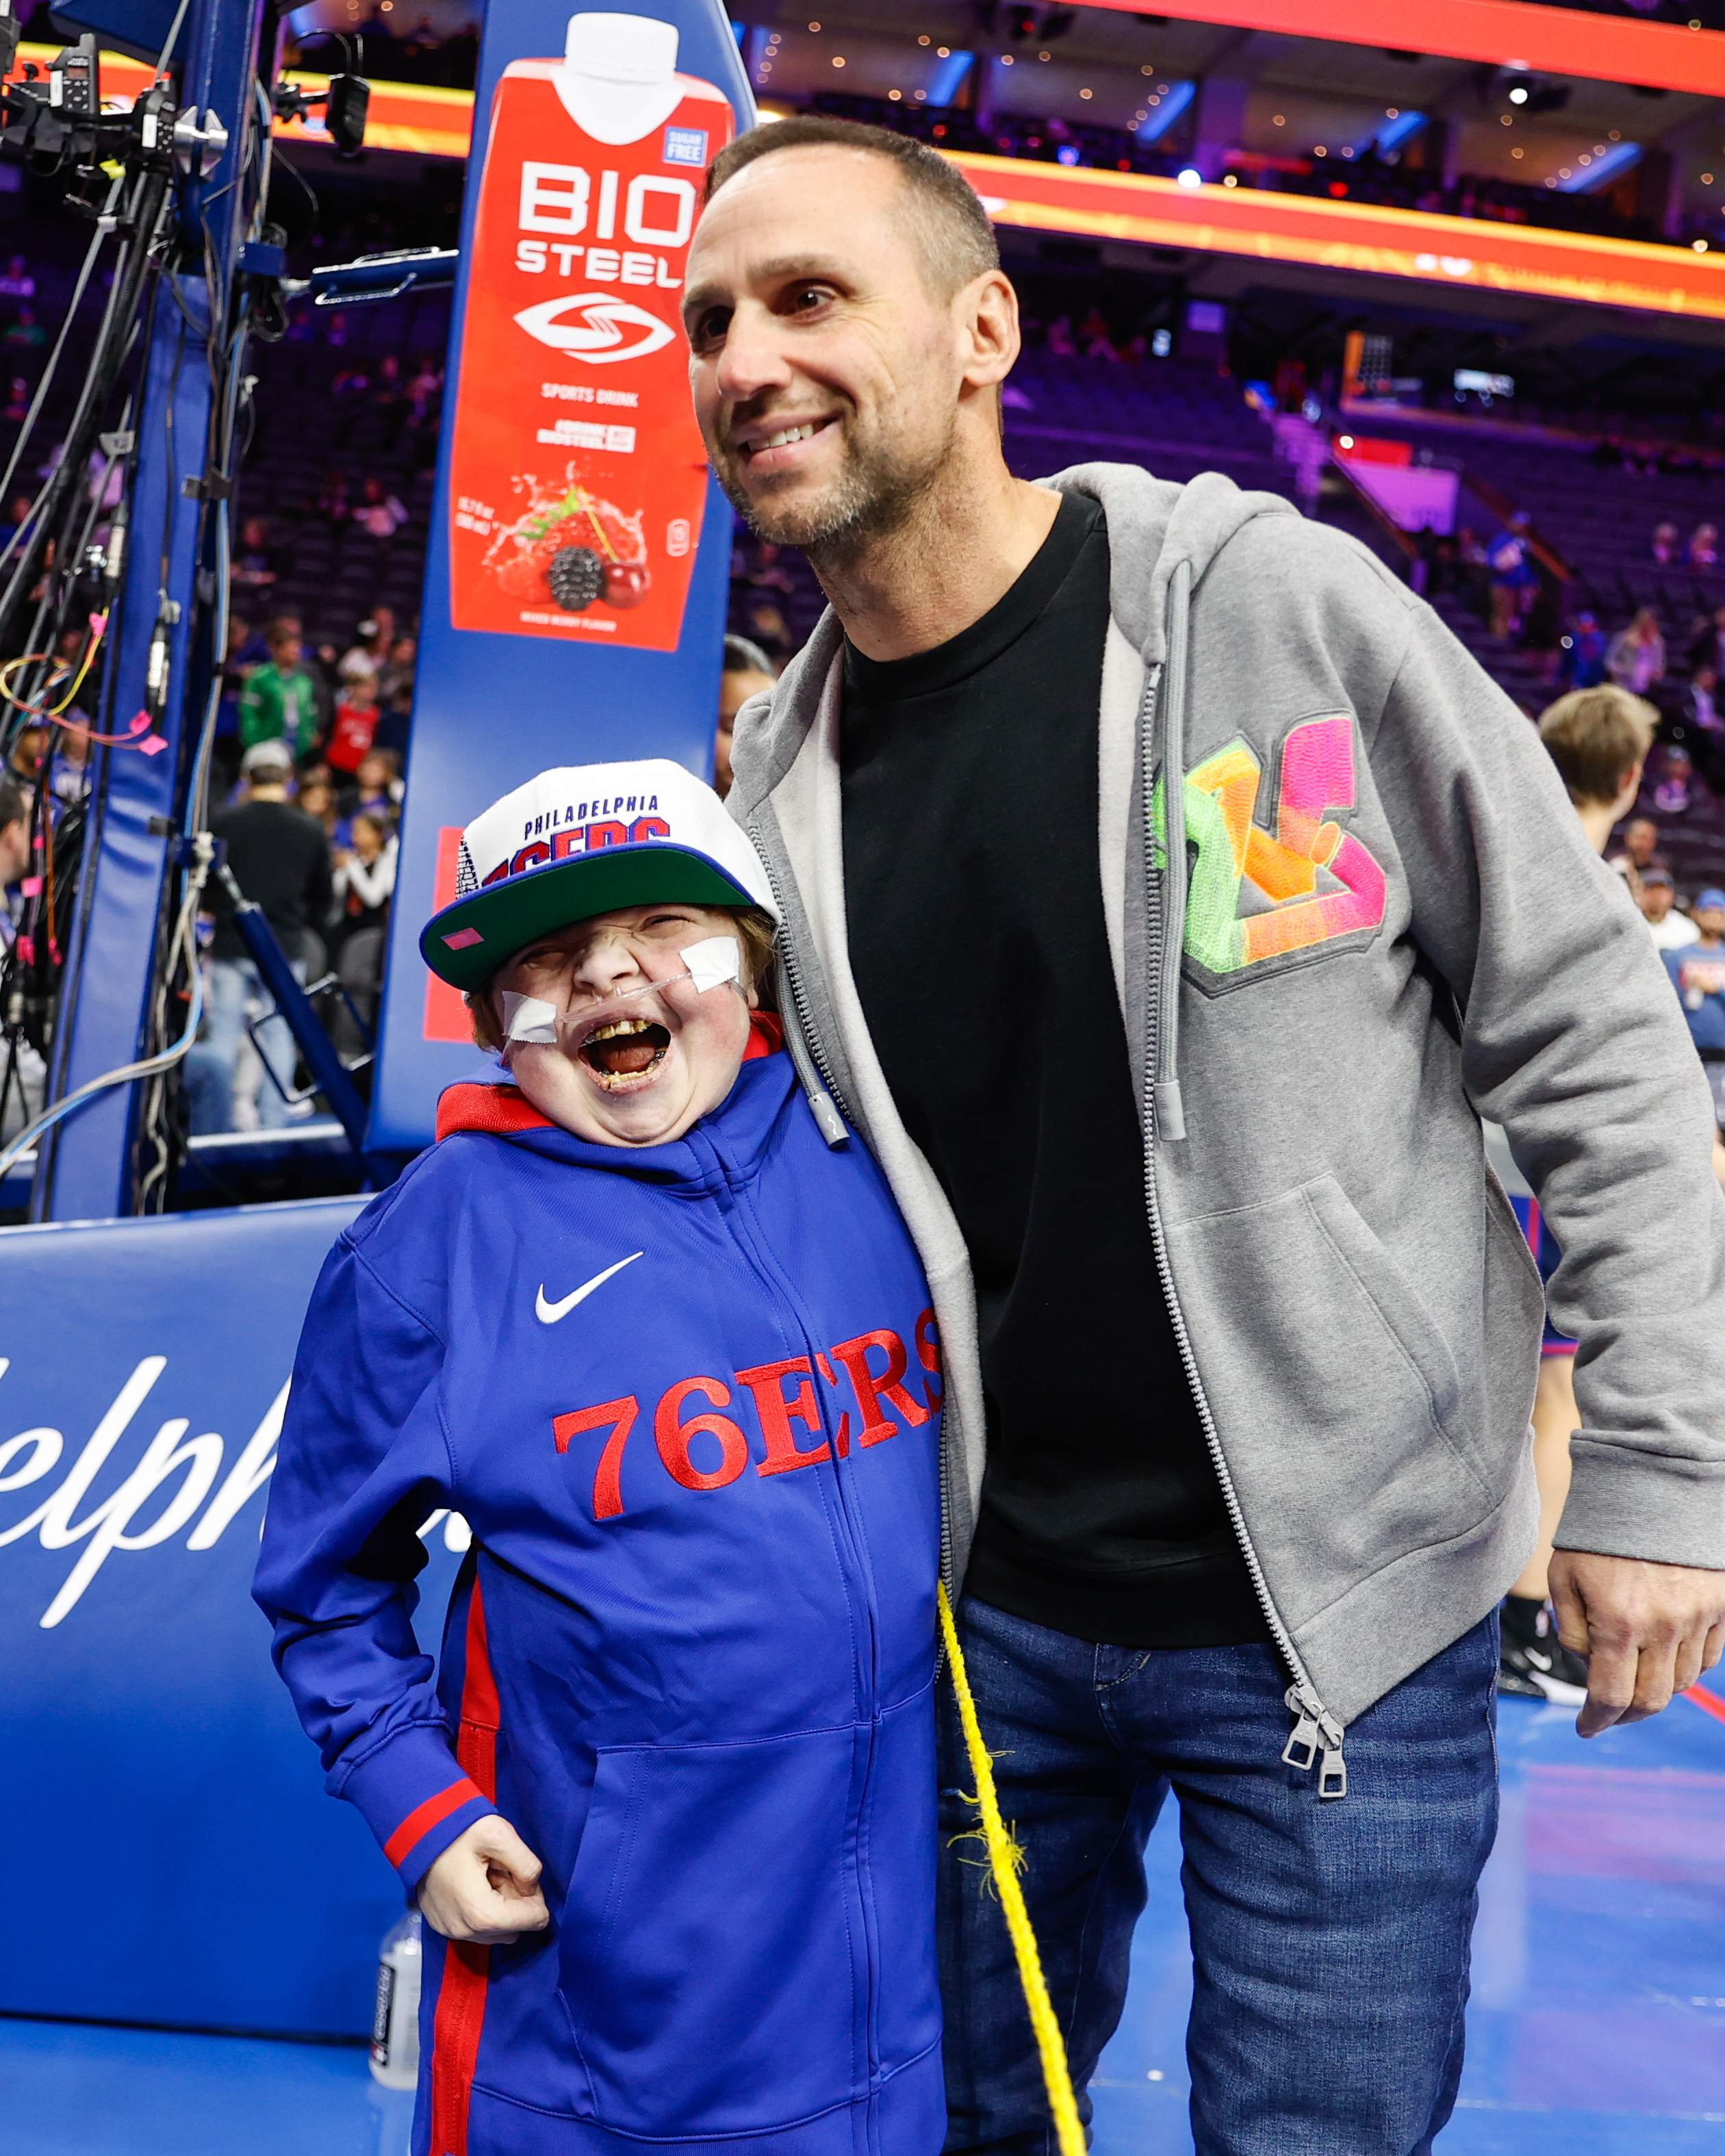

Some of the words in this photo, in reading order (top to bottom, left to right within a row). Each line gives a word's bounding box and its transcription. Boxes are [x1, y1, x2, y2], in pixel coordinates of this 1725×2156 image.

[667, 142, 702, 162] FREE
[669, 131, 702, 146] SUGAR
[518, 161, 696, 248] BIO
[515, 240, 683, 289] STEEL
[541, 382, 595, 403] SPORTS
[596, 389, 639, 408] DRINK
[524, 795, 659, 840] PHILADELPHIA
[552, 1307, 945, 1520] 76ERS
